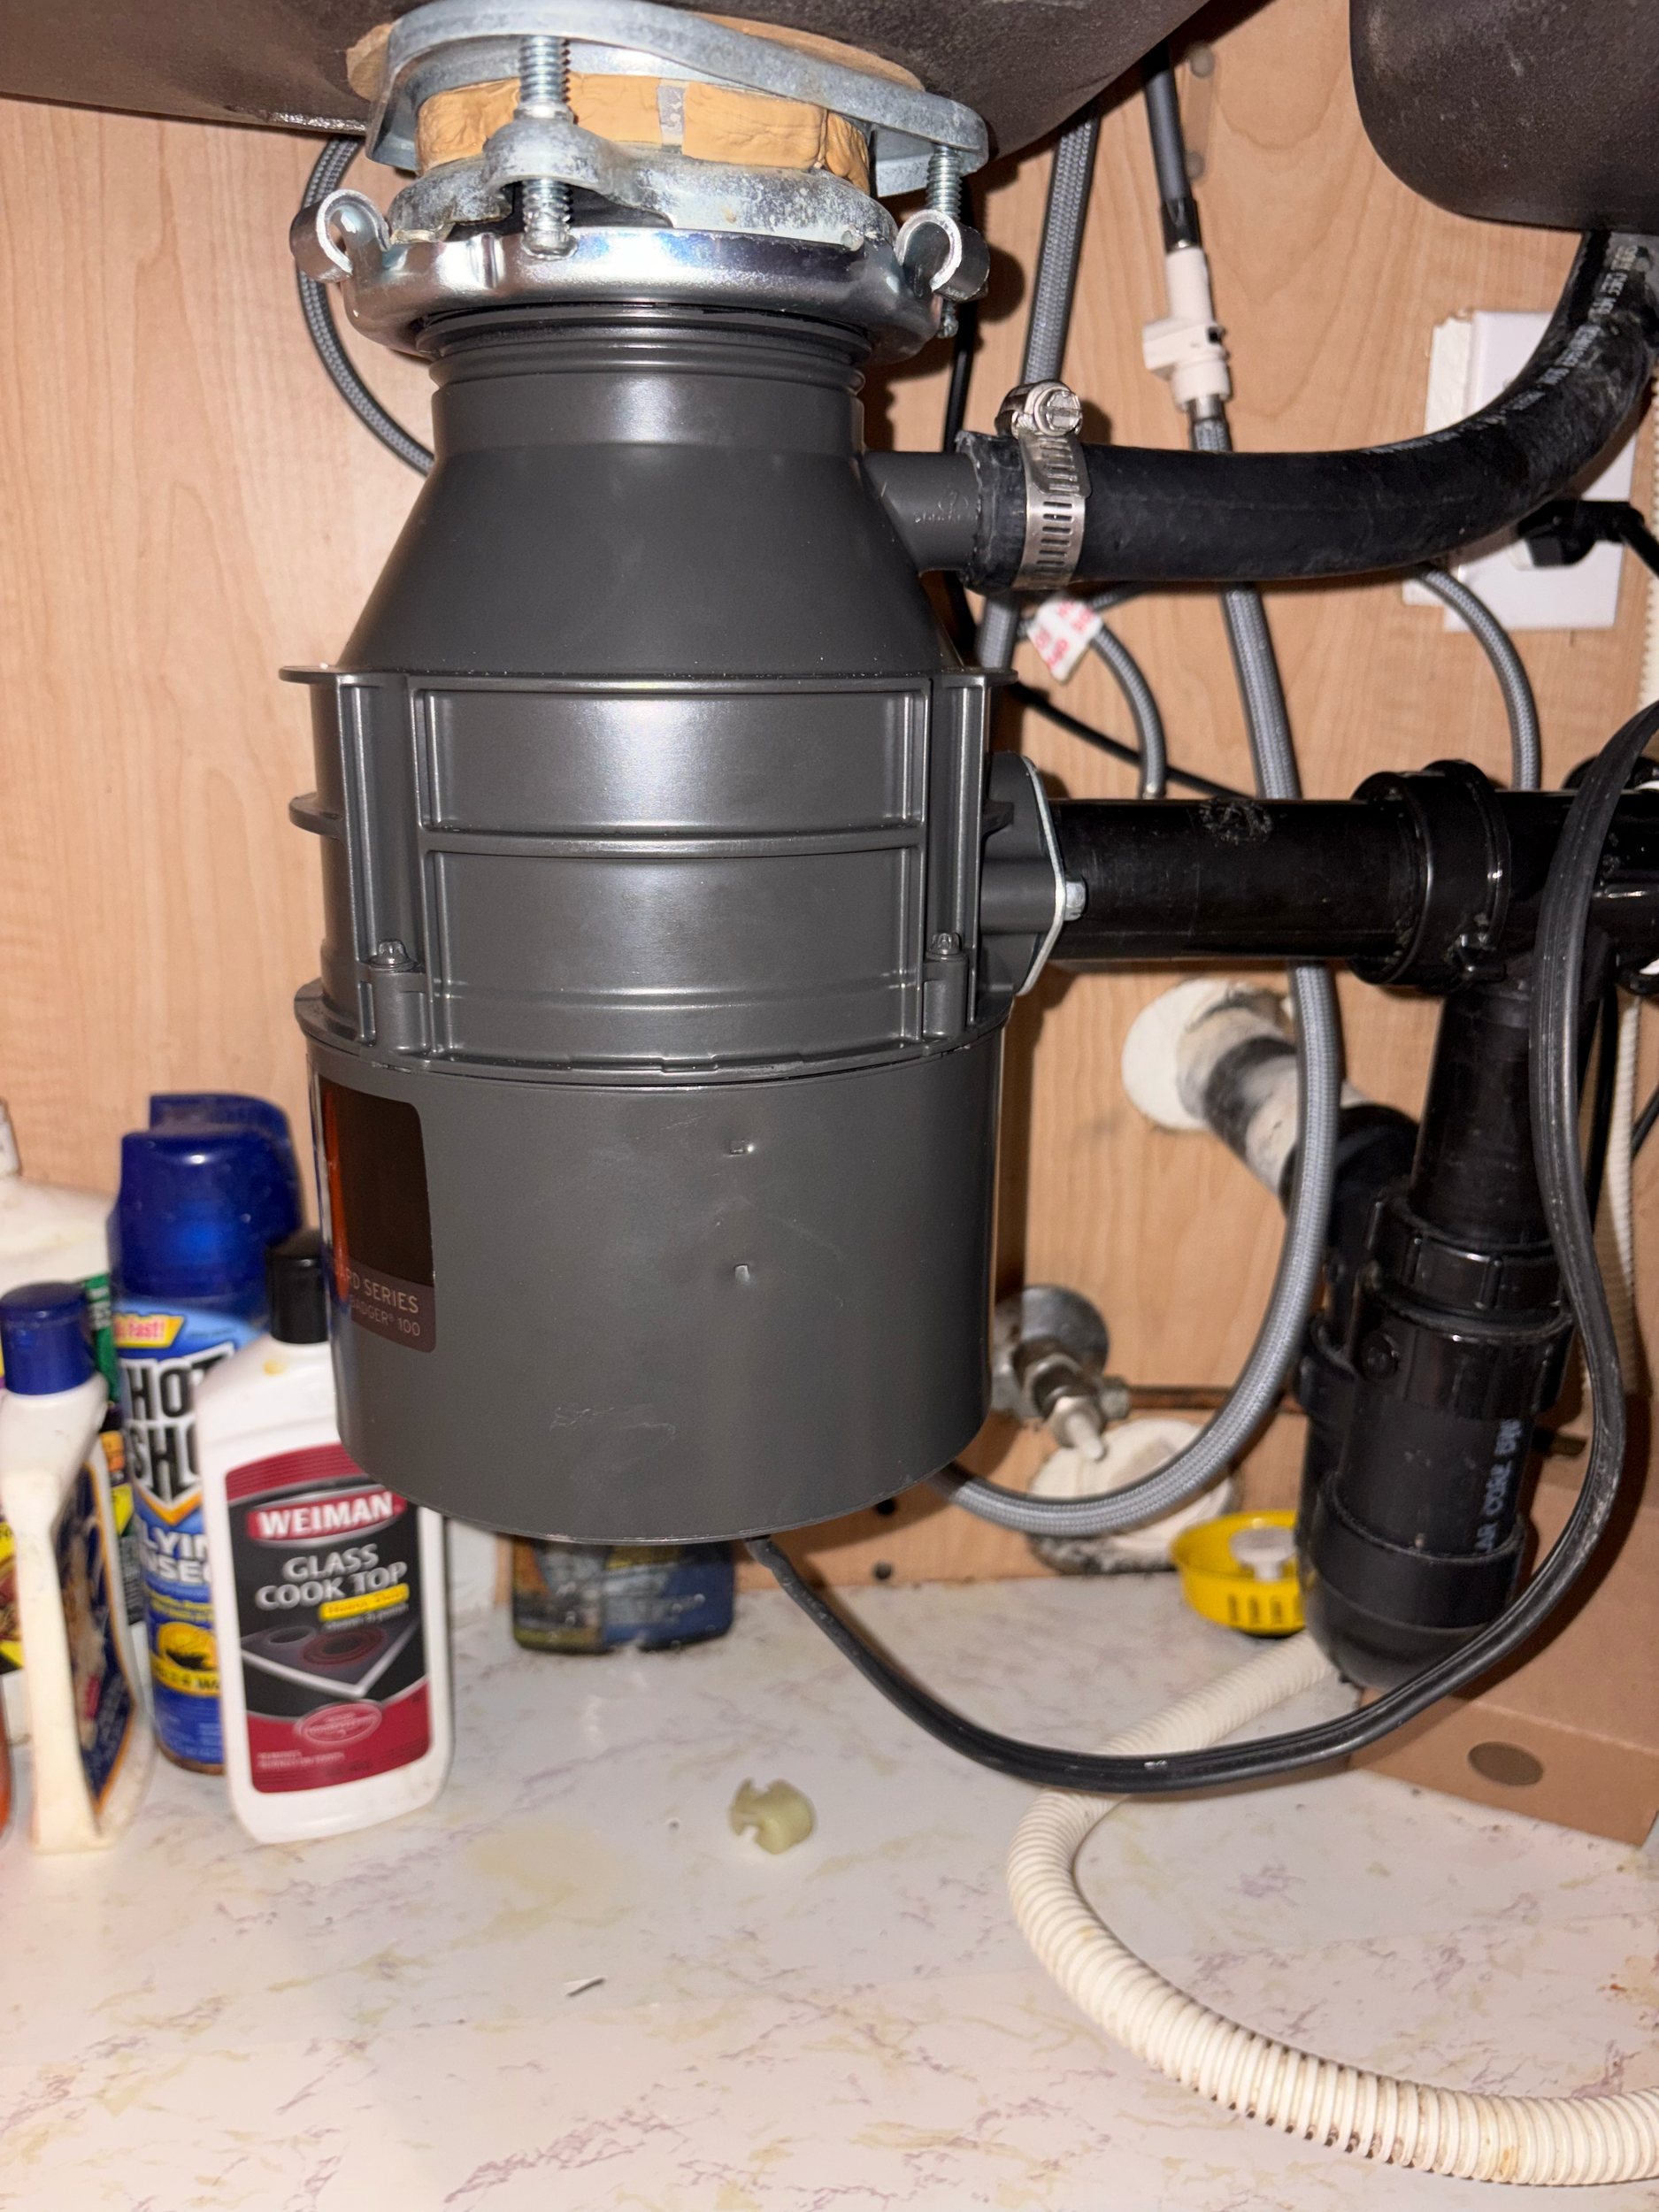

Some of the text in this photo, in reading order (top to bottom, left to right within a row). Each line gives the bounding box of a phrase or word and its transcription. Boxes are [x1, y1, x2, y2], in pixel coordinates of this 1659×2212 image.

[363, 1278, 419, 1314] SERIES
[397, 1316, 421, 1337] 100
[257, 1490, 394, 1540] WEIMAN
[282, 1542, 380, 1583] GLASS
[255, 1561, 409, 1611] COOK TOP
